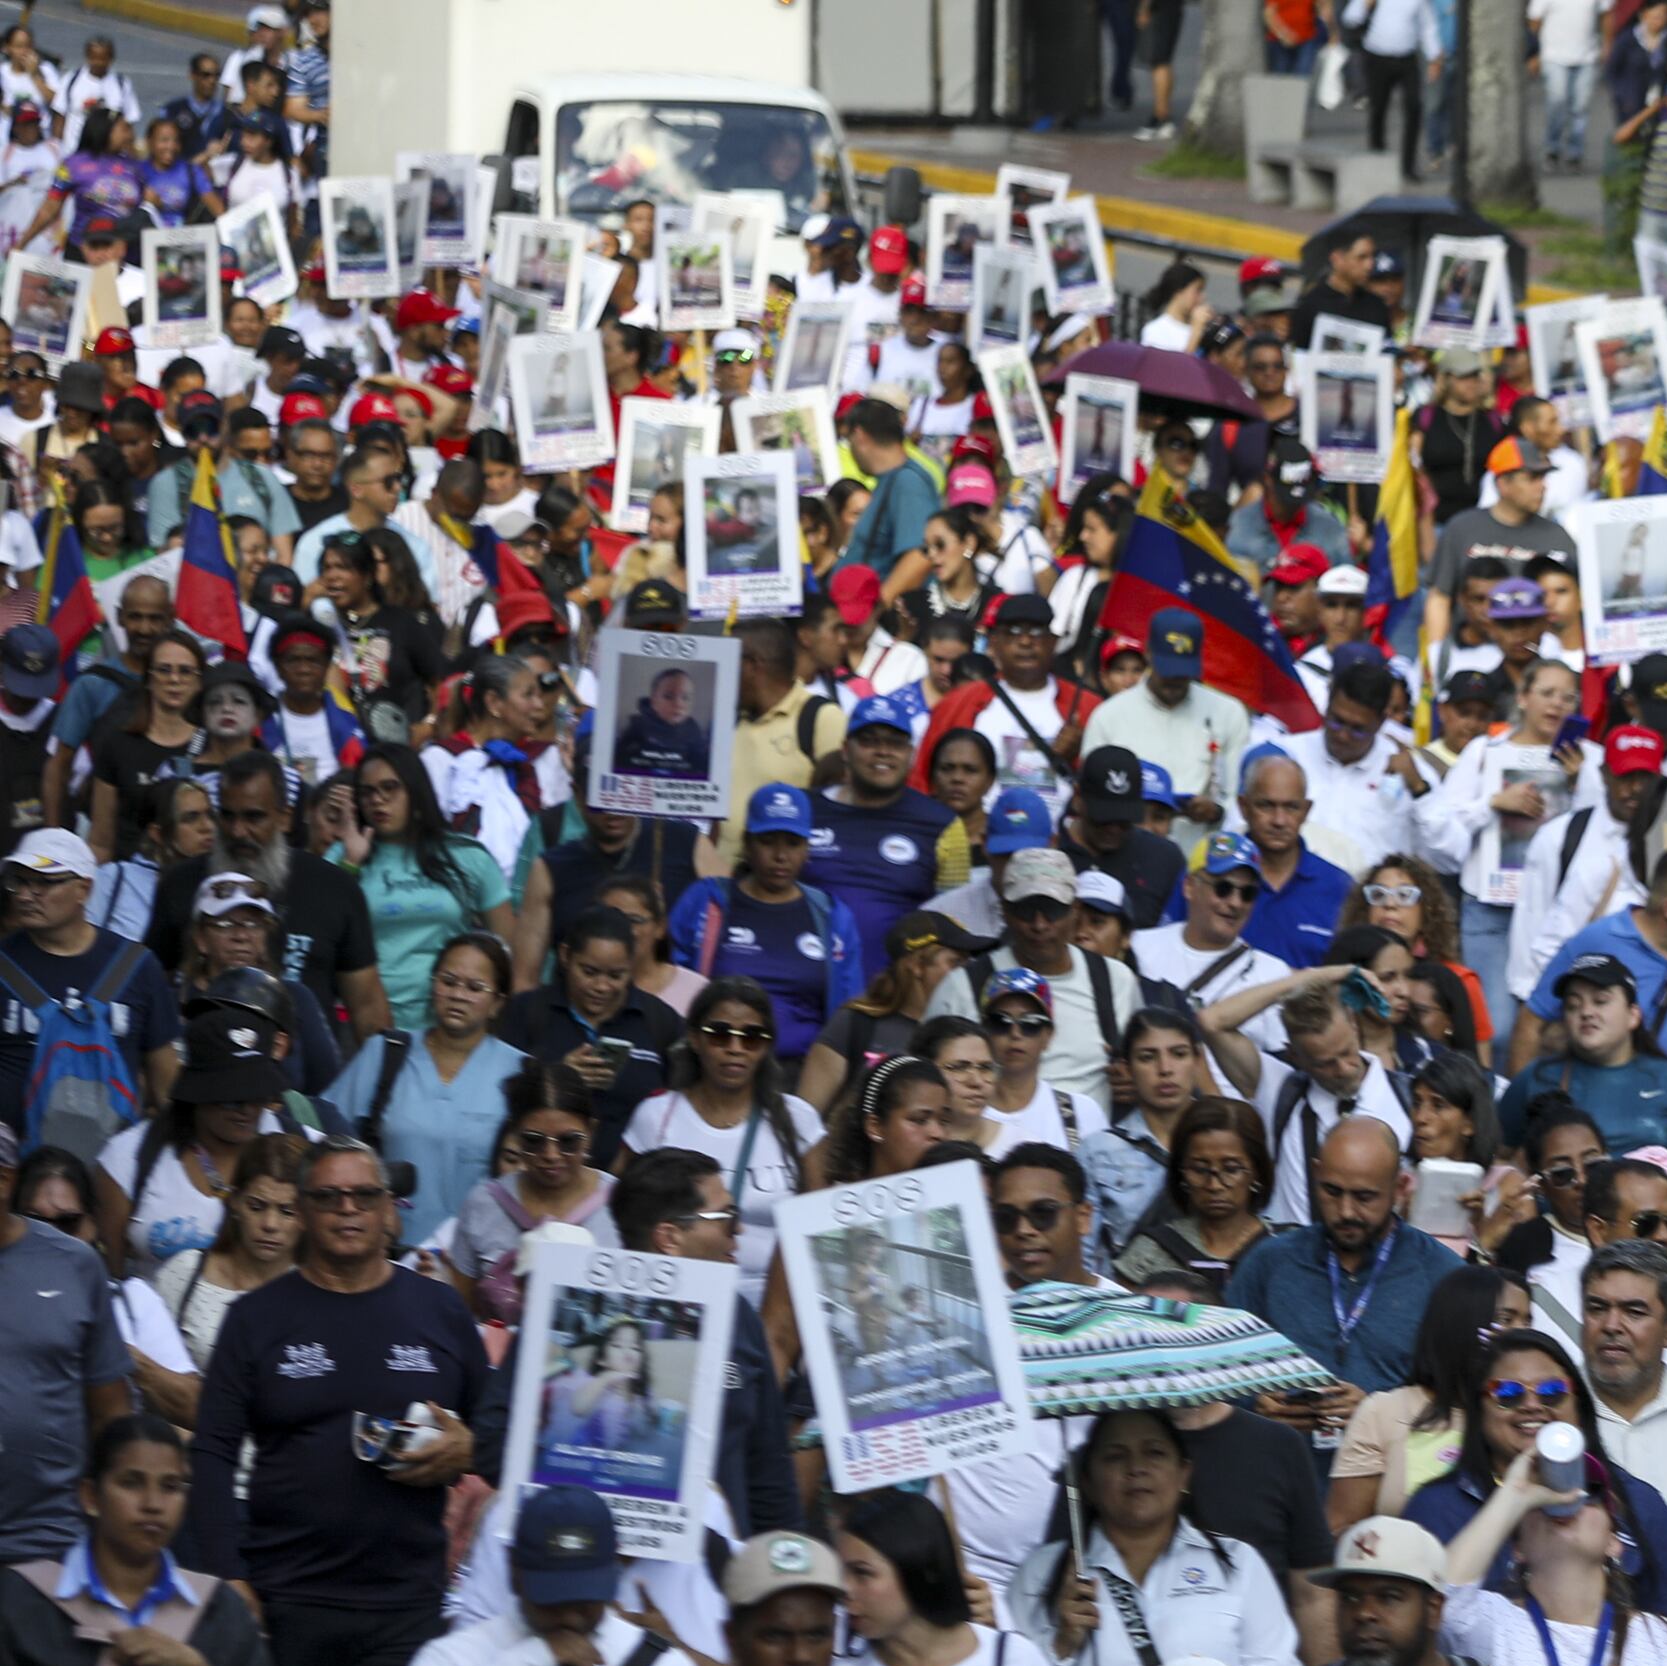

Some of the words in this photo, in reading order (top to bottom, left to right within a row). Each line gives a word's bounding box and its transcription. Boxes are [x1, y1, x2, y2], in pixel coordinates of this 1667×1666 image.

[831, 1177, 923, 1226] SOS
[586, 1251, 677, 1295] SOS
[845, 1421, 929, 1481] USA
